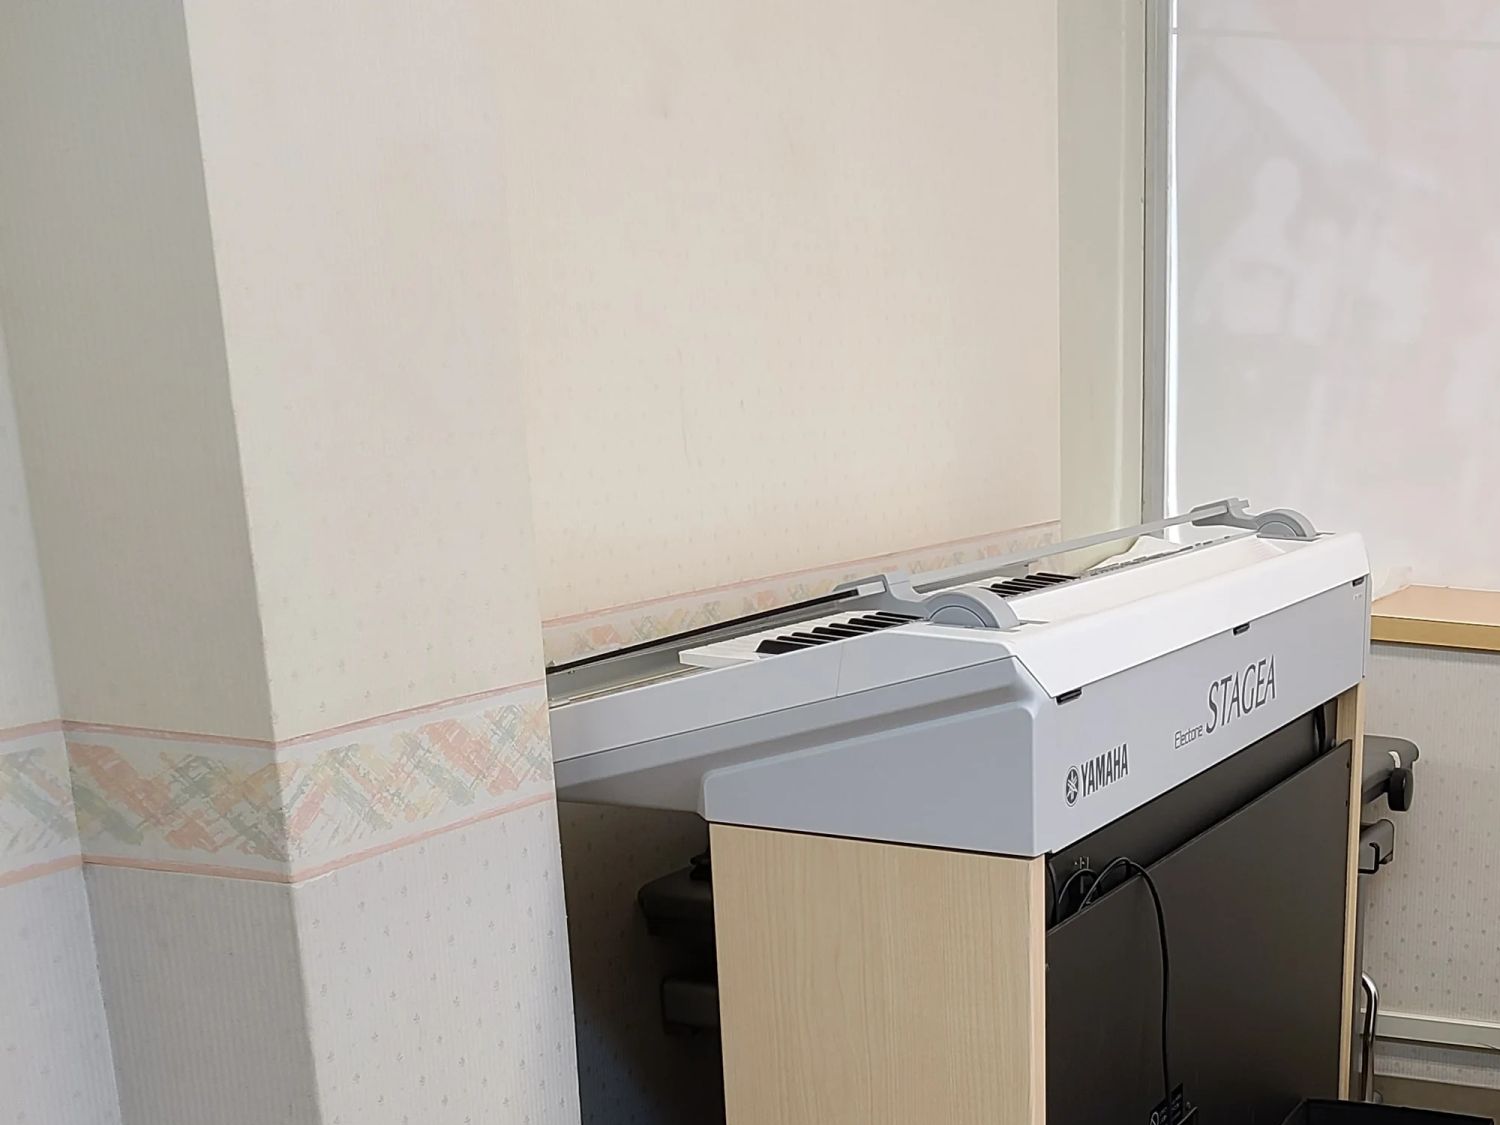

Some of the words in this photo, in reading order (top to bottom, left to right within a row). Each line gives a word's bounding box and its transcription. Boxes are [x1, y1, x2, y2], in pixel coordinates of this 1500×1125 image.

[1206, 654, 1275, 735] STAGEA
[1175, 725, 1203, 749] Electone
[1081, 744, 1128, 797] YAMAHA
